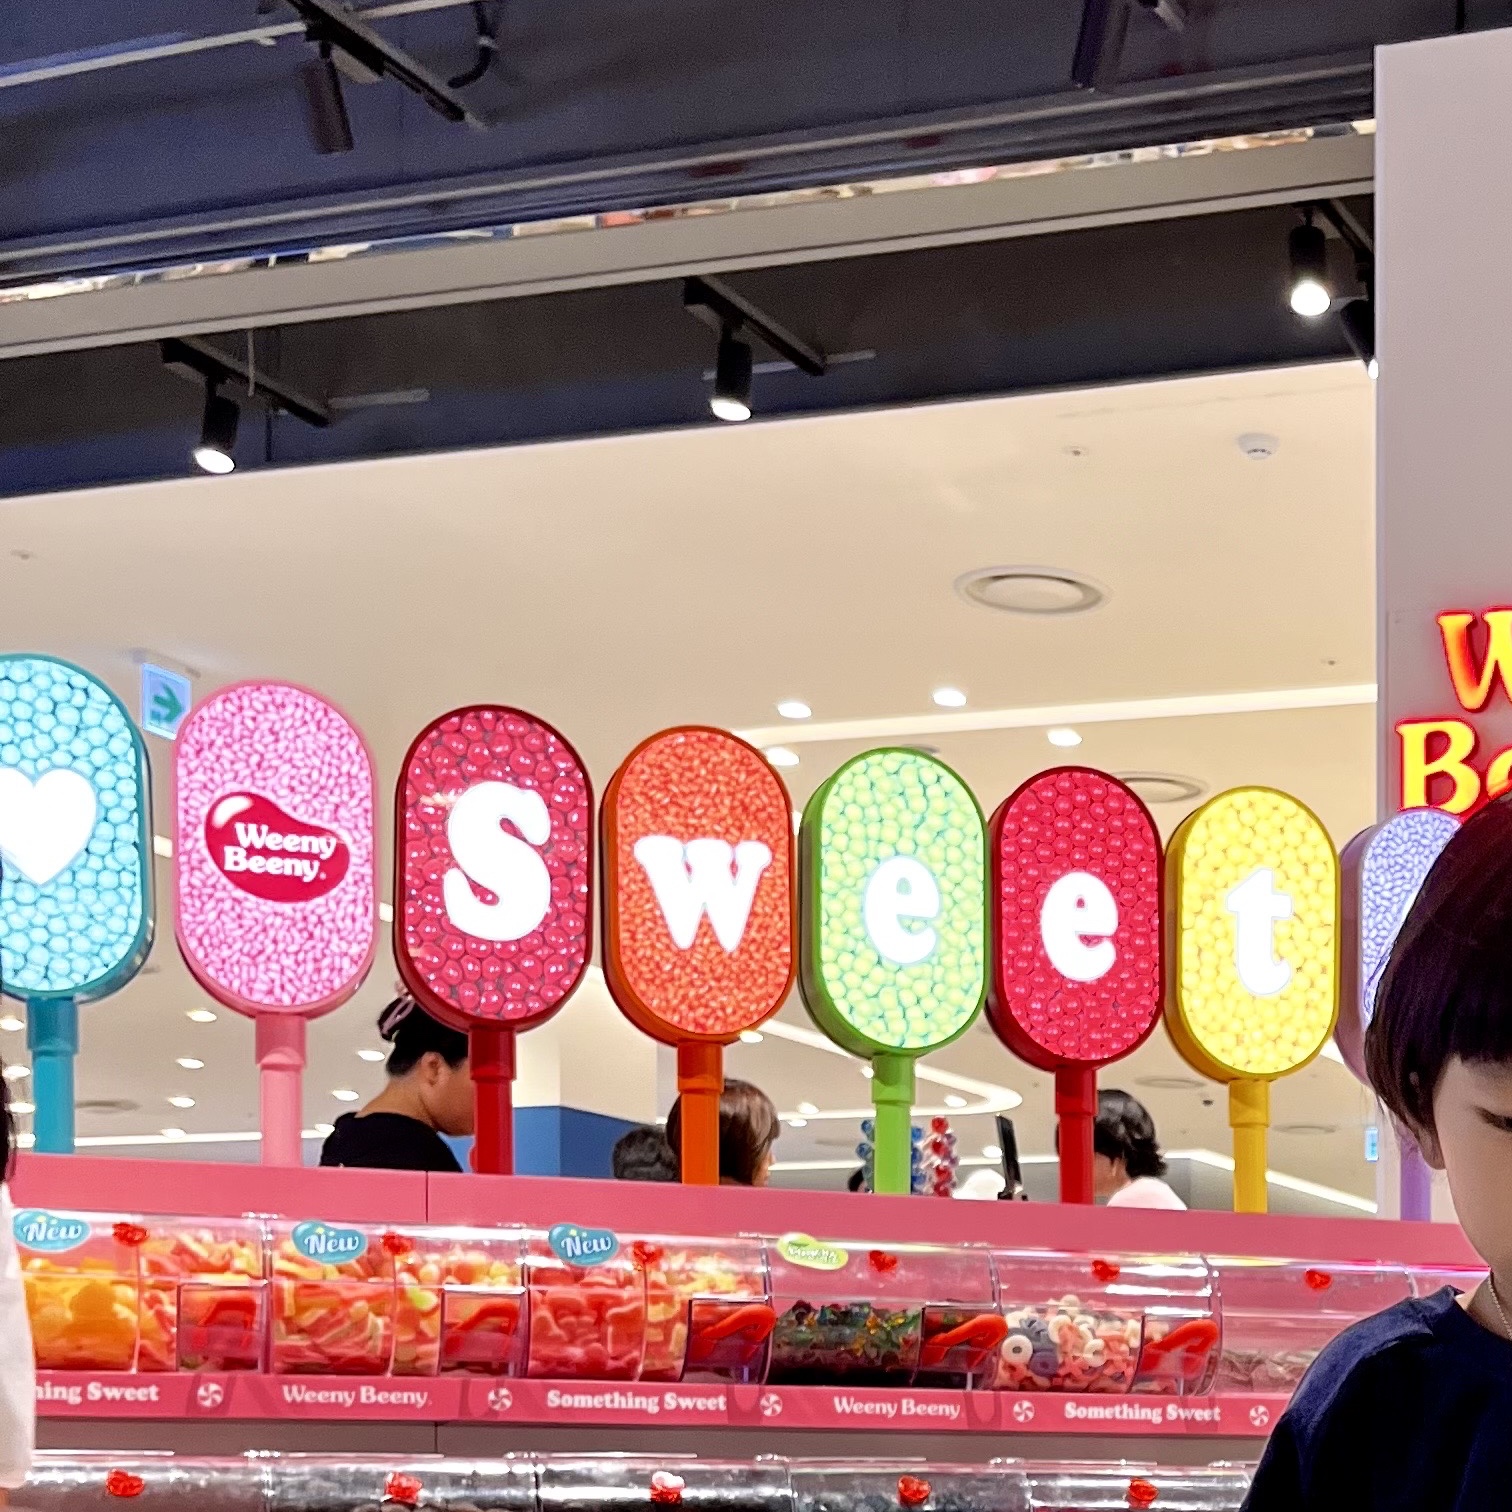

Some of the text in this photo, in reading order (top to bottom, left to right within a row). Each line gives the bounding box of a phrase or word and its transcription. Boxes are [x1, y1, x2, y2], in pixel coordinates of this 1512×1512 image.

[234, 821, 337, 860] Weeny
[22, 1221, 83, 1242] New
[303, 1232, 360, 1254] New
[560, 1234, 613, 1257] New
[86, 1381, 159, 1401] Sweet
[282, 1384, 355, 1406] Weeny
[547, 1390, 726, 1413] Something Sweet
[834, 1396, 898, 1417] Weeny
[1064, 1402, 1221, 1423] Something Sweet
